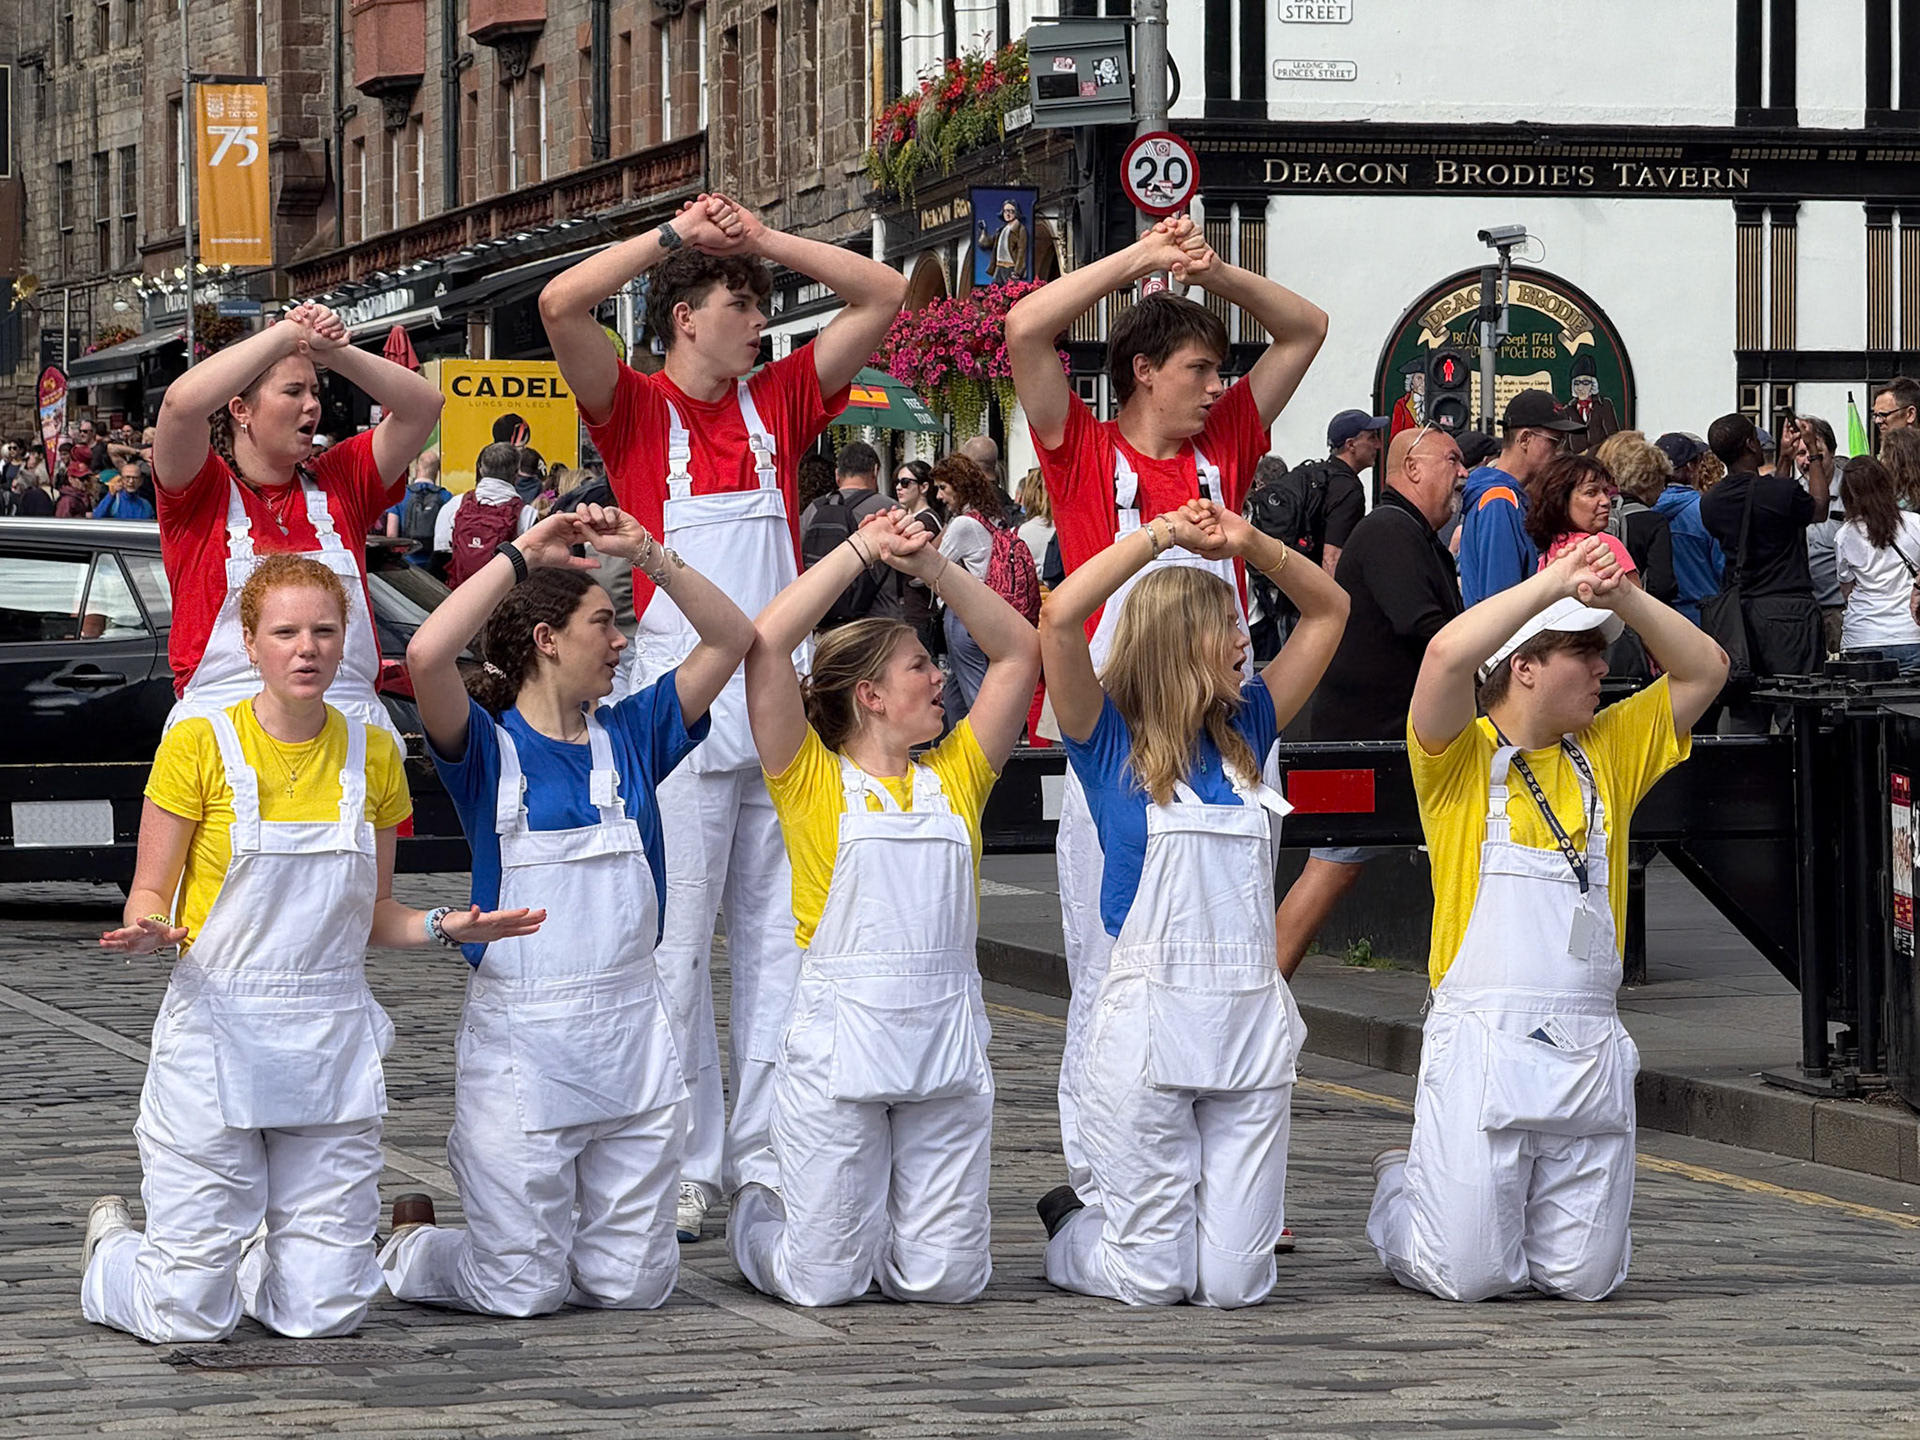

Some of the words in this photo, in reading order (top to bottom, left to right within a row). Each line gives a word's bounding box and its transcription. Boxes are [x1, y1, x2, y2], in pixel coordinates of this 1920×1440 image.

[1286, 5, 1346, 20] STREET
[1293, 61, 1323, 69] LEADING
[1277, 68, 1314, 77] PRINCES
[1318, 69, 1353, 78] STREET
[207, 126, 259, 167] 75
[1135, 156, 1188, 190] 20
[1263, 159, 1409, 185] DEACON
[1434, 160, 1595, 187] BRODIE'S
[1612, 162, 1750, 189] TAVERN
[1517, 284, 1589, 335] BRODIE
[1532, 332, 1553, 345] 1741
[1532, 346, 1557, 359] 1788
[451, 375, 569, 398] CADEL
[902, 397, 924, 410] FREE
[913, 412, 936, 425] TOUR
